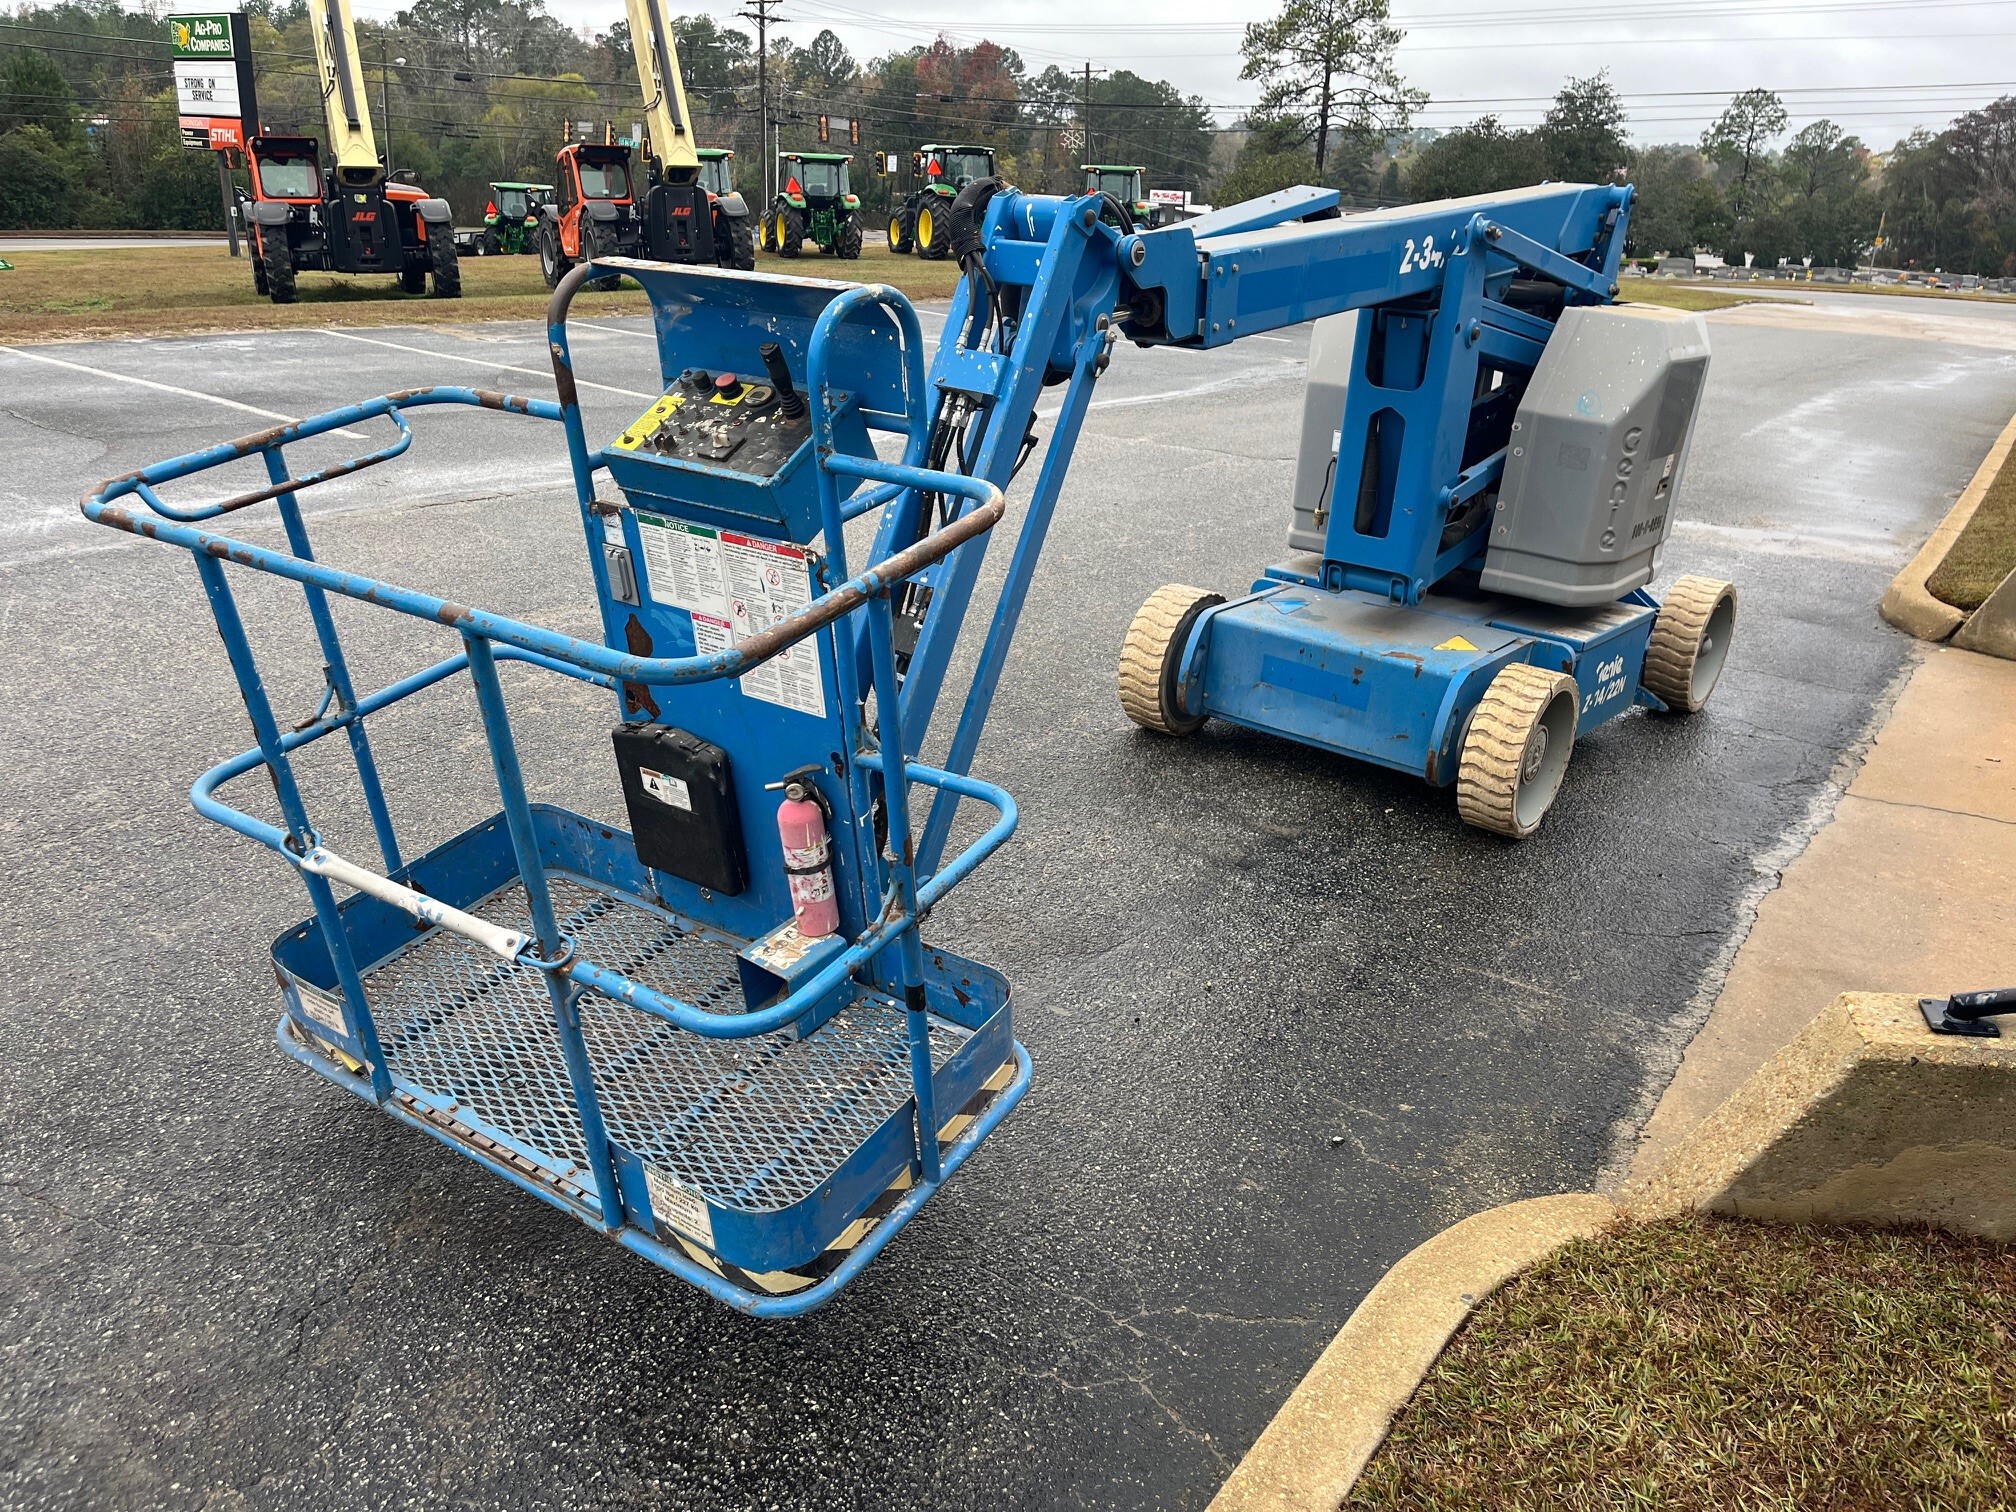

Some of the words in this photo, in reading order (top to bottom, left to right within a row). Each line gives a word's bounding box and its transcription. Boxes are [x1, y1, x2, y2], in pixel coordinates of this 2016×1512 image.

[190, 37, 230, 52] COMPANIES
[184, 78, 204, 89] STRONG
[208, 78, 216, 89] ON
[192, 90, 214, 101] SERVICE
[211, 128, 238, 143] STIHL
[183, 138, 203, 147] Equipment
[352, 211, 376, 222] JLG
[671, 207, 692, 216] JLG
[664, 520, 689, 533] NOTICE
[752, 540, 778, 553] DANGER
